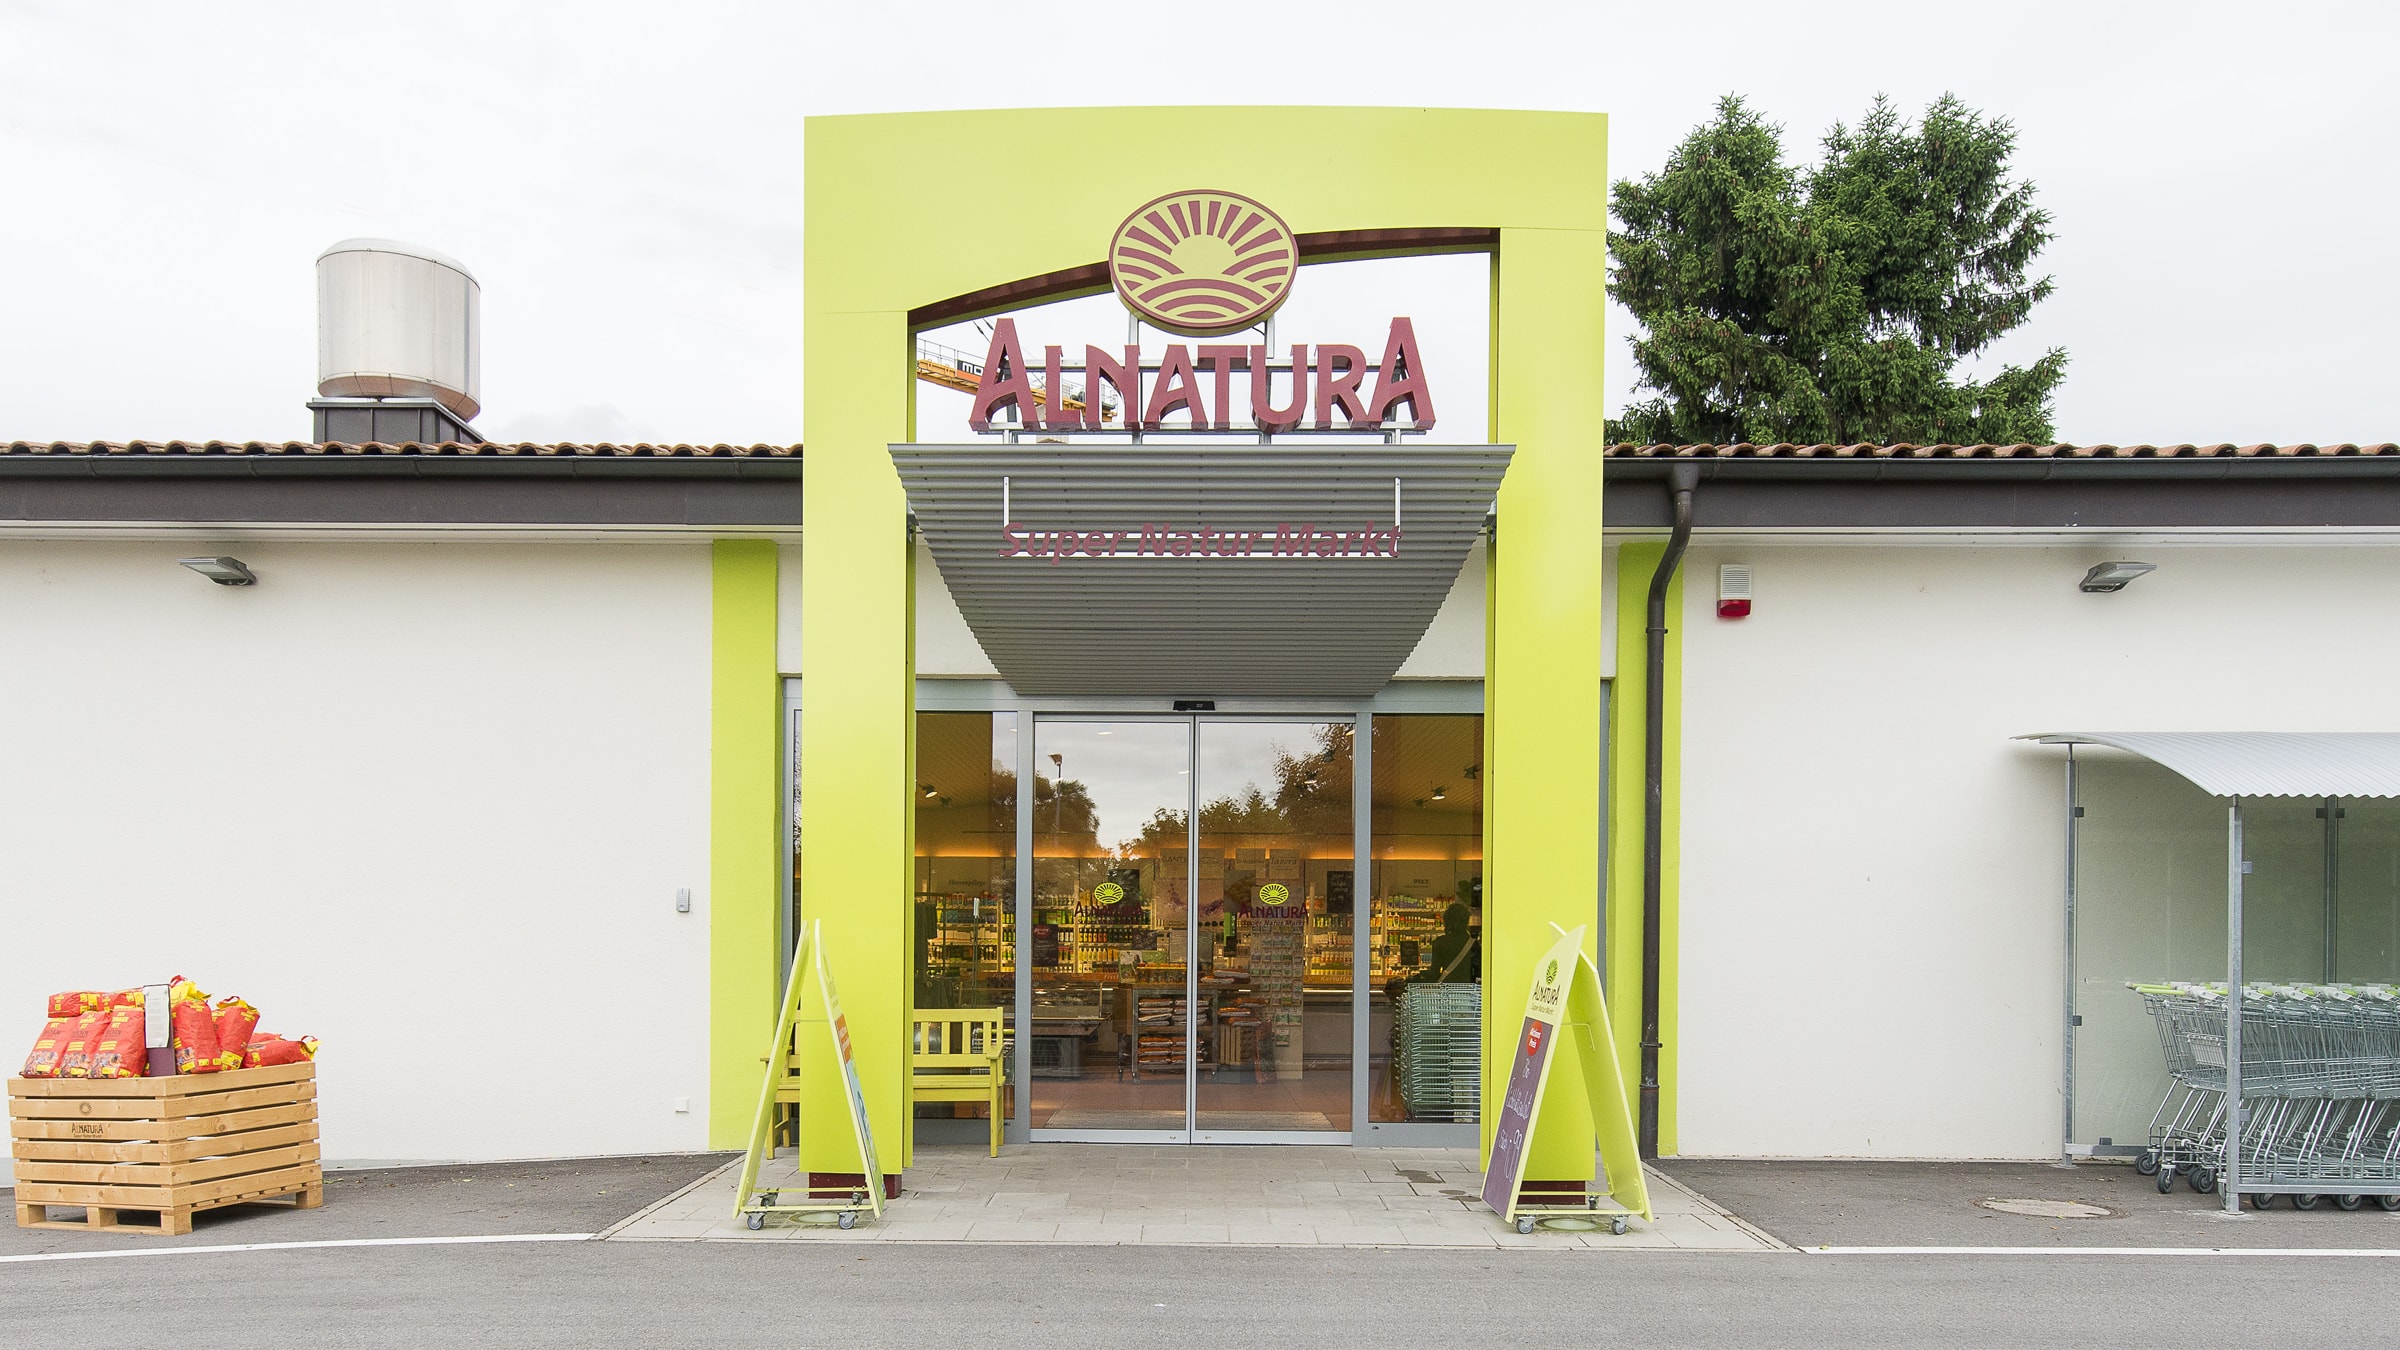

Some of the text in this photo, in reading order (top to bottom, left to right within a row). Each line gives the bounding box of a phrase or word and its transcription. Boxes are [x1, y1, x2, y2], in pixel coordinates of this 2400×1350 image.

[969, 317, 1436, 432] ALNATURA
[999, 520, 1402, 565] Super Natur Markt
[1238, 902, 1309, 919] ALNATURA
[1532, 980, 1561, 1006] ALNATURA
[71, 1122, 104, 1134] ALNATURA
